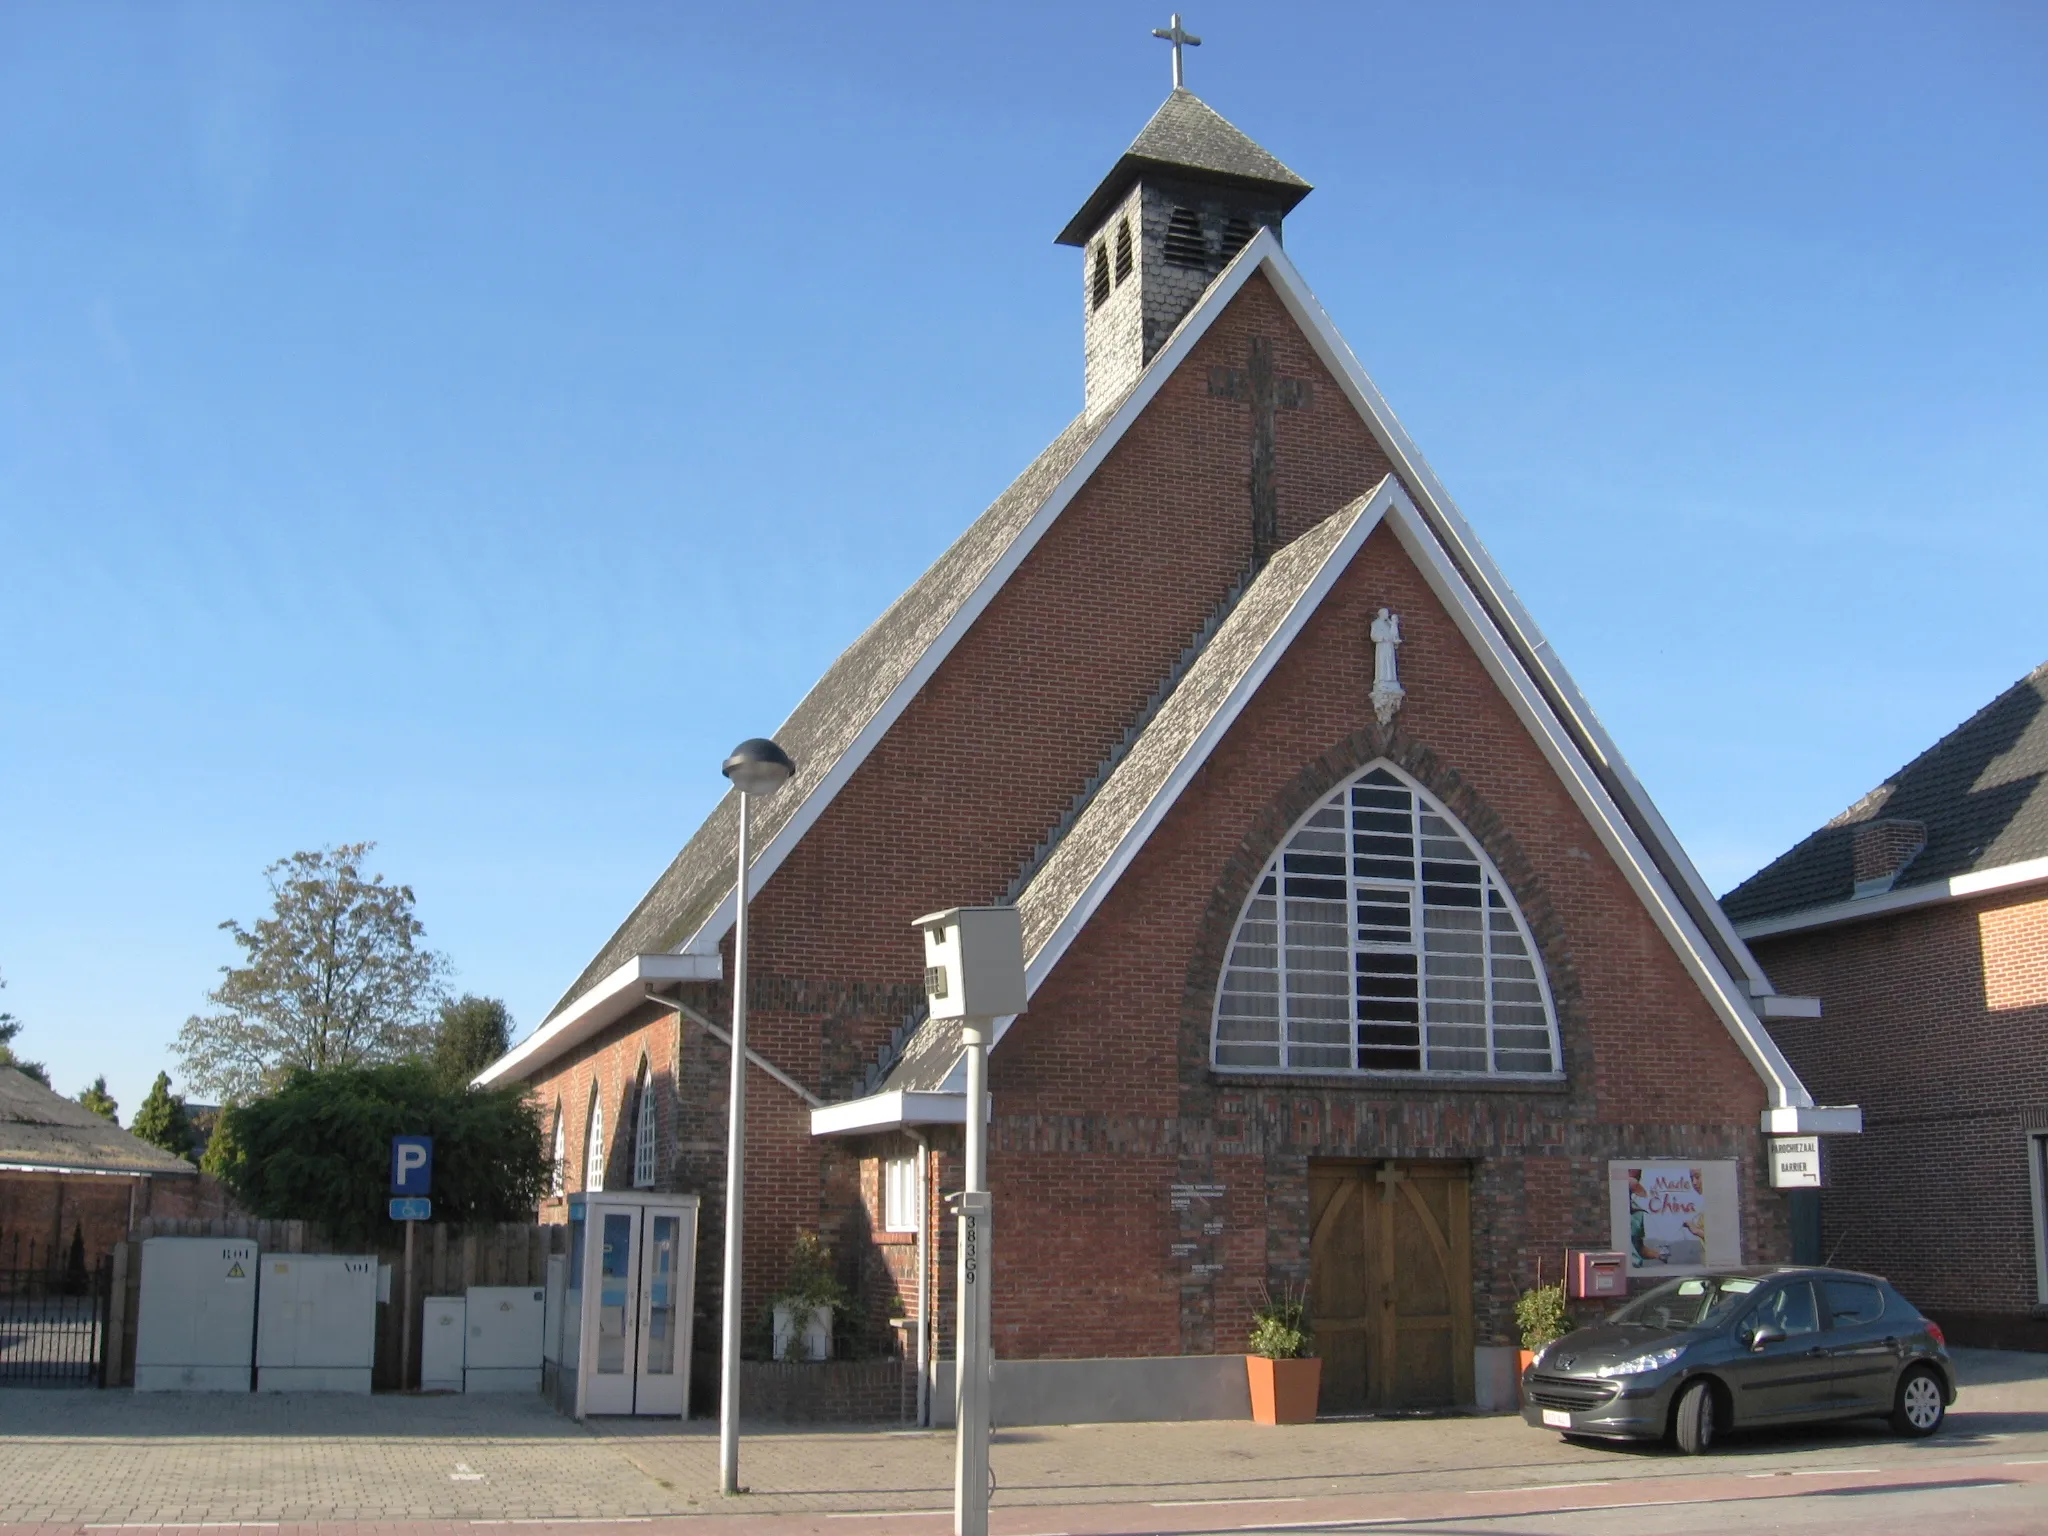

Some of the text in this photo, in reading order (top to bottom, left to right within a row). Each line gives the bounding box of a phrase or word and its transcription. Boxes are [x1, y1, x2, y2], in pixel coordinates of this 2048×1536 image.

[1771, 1143, 1816, 1153] PAROCHIEZAAL
[397, 1144, 426, 1185] P
[1781, 1162, 1807, 1172] BARRIER
[1653, 1176, 1691, 1189] Made
[1648, 1192, 1696, 1214] China
[965, 1215, 976, 1285] 383G9
